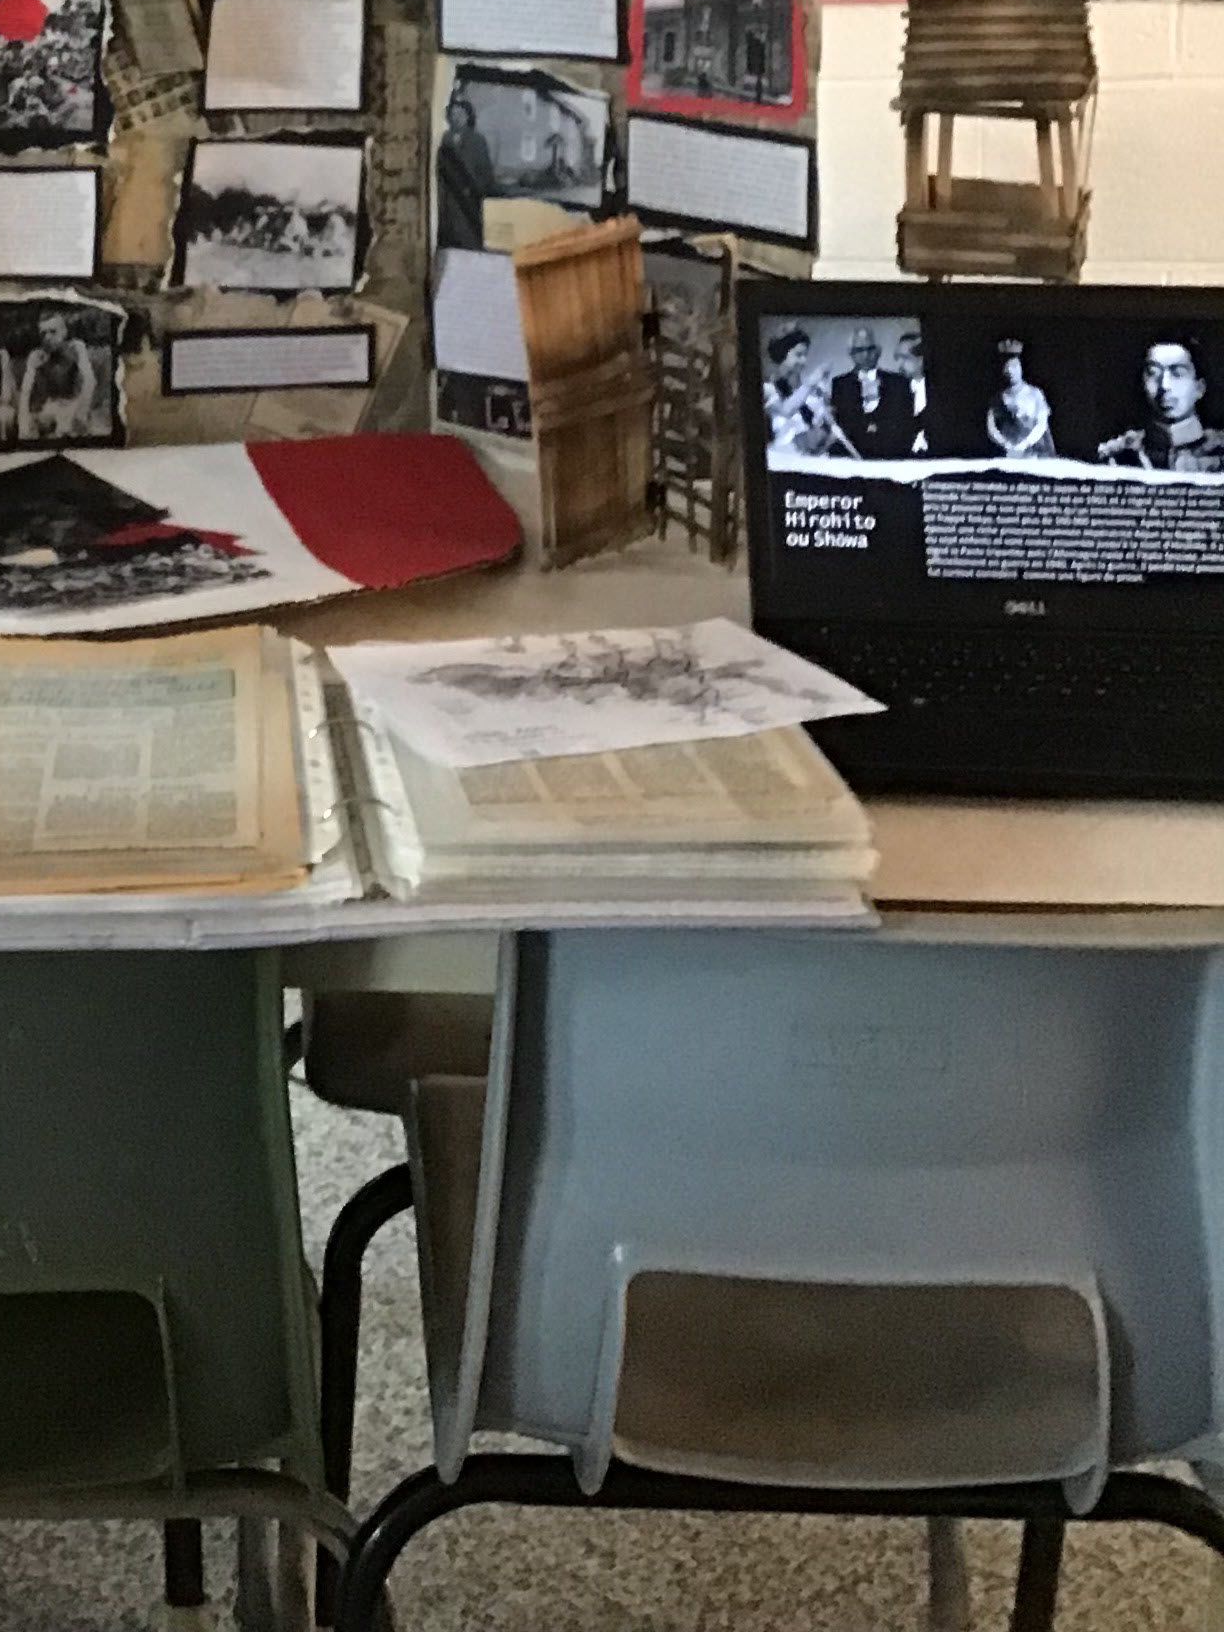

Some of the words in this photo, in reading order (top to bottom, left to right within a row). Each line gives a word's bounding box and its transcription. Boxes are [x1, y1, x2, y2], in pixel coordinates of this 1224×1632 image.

[784, 489, 864, 512] Emperor
[784, 510, 877, 531] Hirohito
[785, 532, 810, 547] ou
